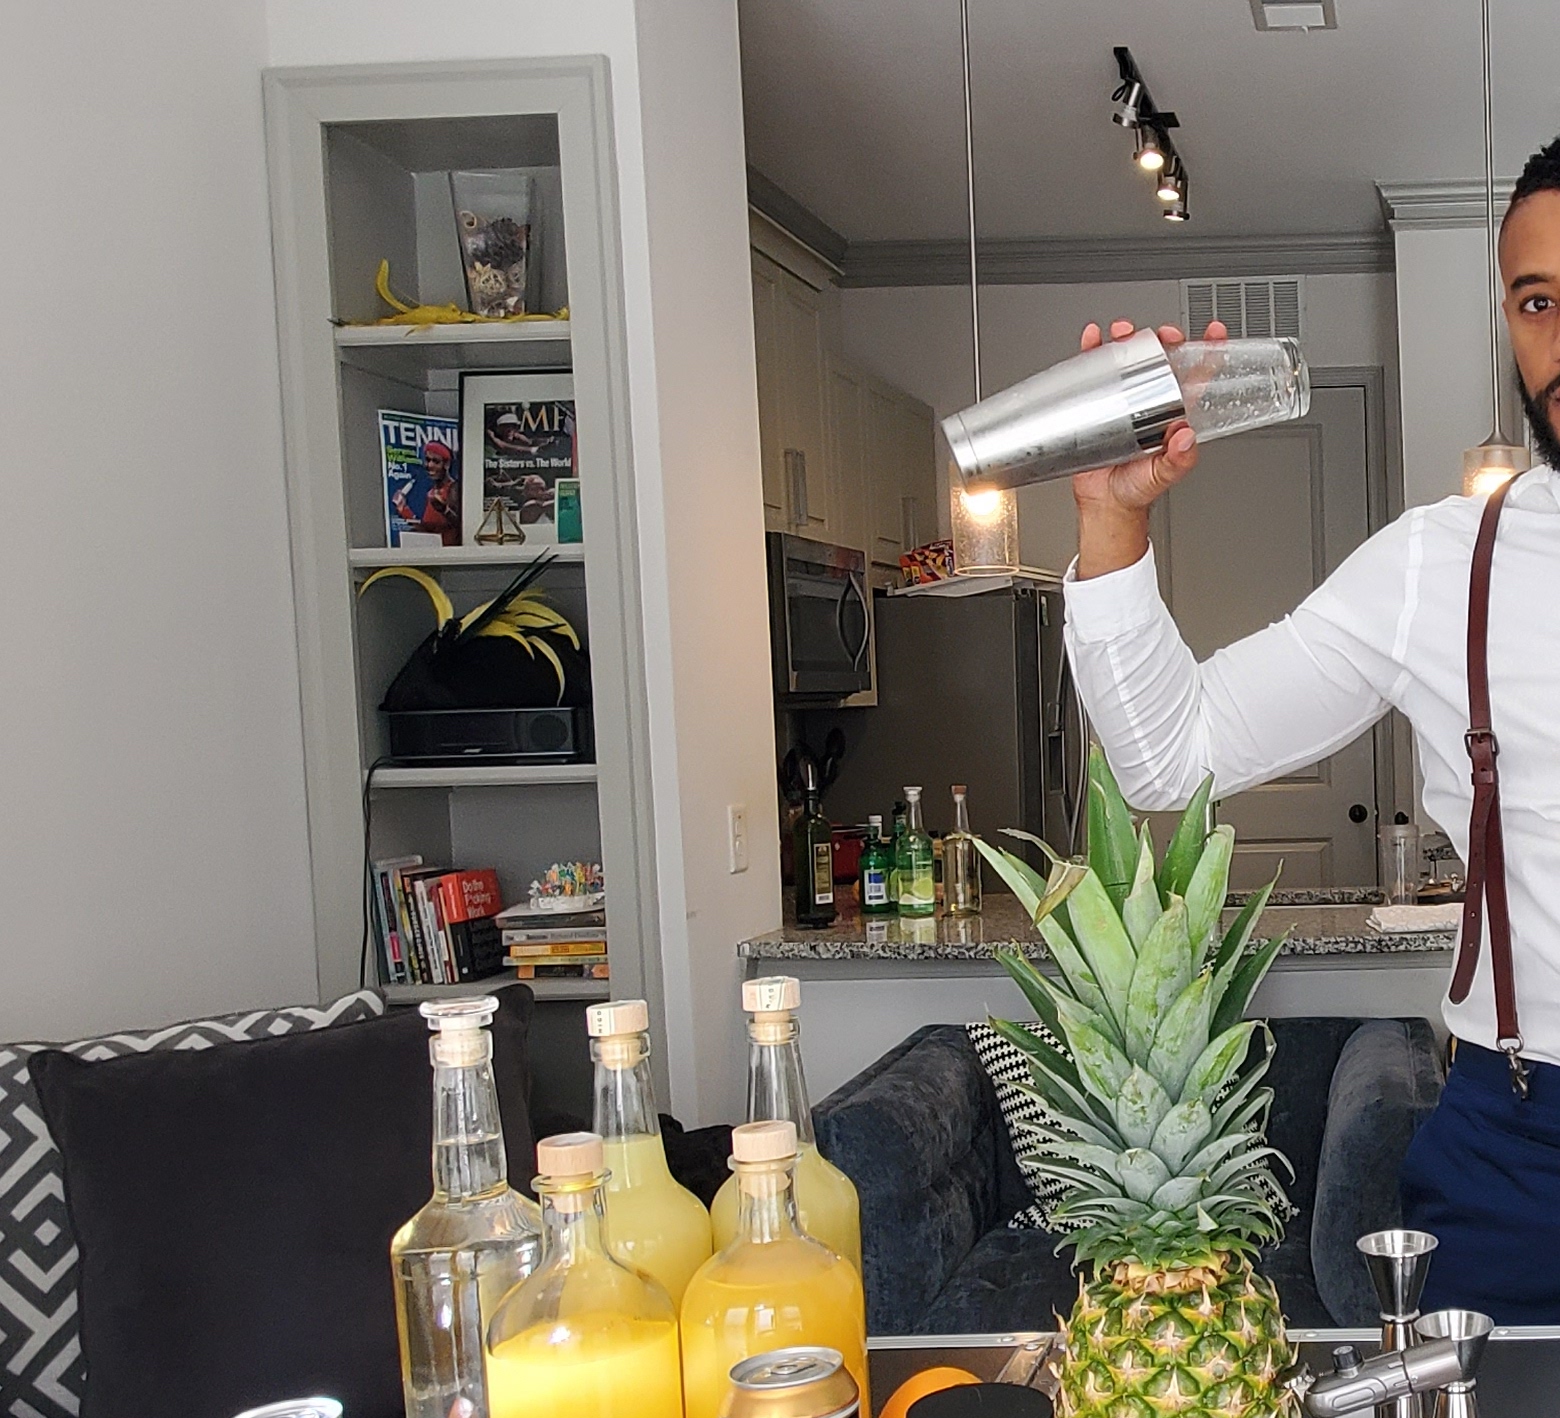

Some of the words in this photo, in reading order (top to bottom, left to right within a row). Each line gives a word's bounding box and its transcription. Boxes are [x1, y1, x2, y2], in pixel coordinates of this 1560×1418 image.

[383, 422, 459, 452] TENNI
[485, 459, 498, 469] The
[499, 460, 524, 469] Sisters
[536, 458, 549, 468] The
[551, 457, 571, 467] World
